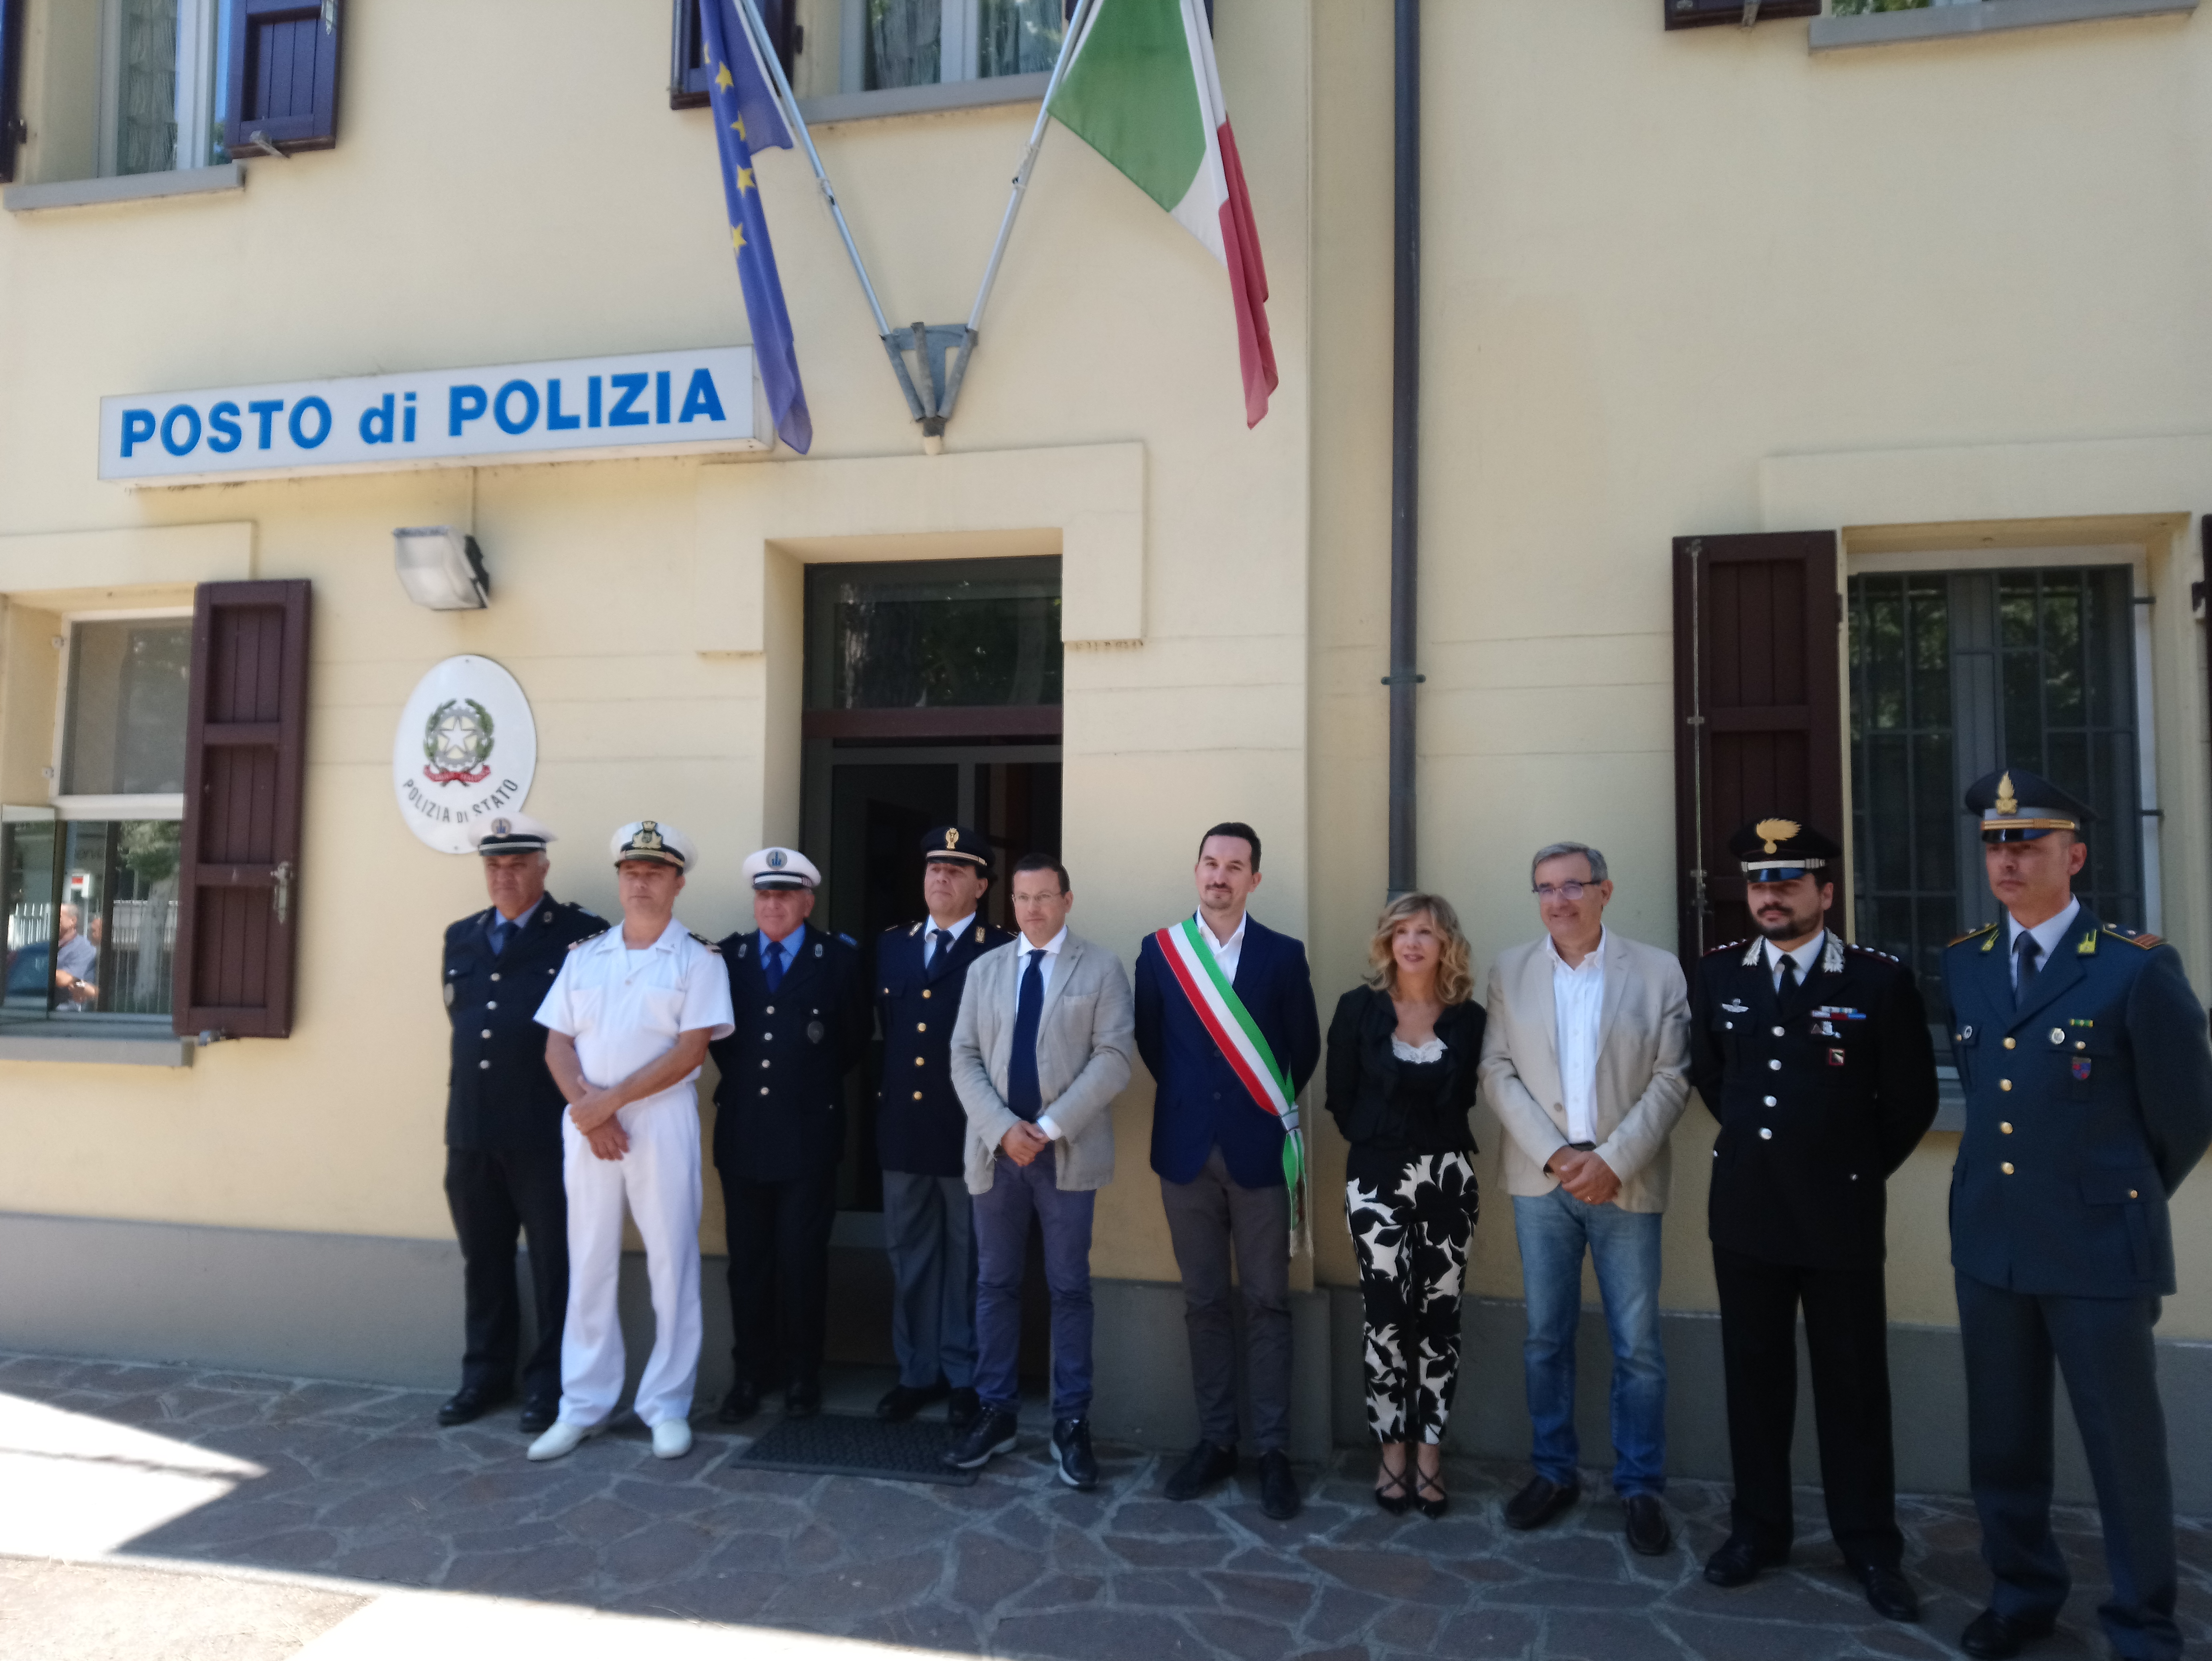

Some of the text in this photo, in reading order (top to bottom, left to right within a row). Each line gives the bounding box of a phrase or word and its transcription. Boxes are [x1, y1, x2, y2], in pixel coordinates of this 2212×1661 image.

[120, 368, 727, 458] POSTO di POLIZIA
[403, 778, 519, 823] POLIZIA DI STATO
